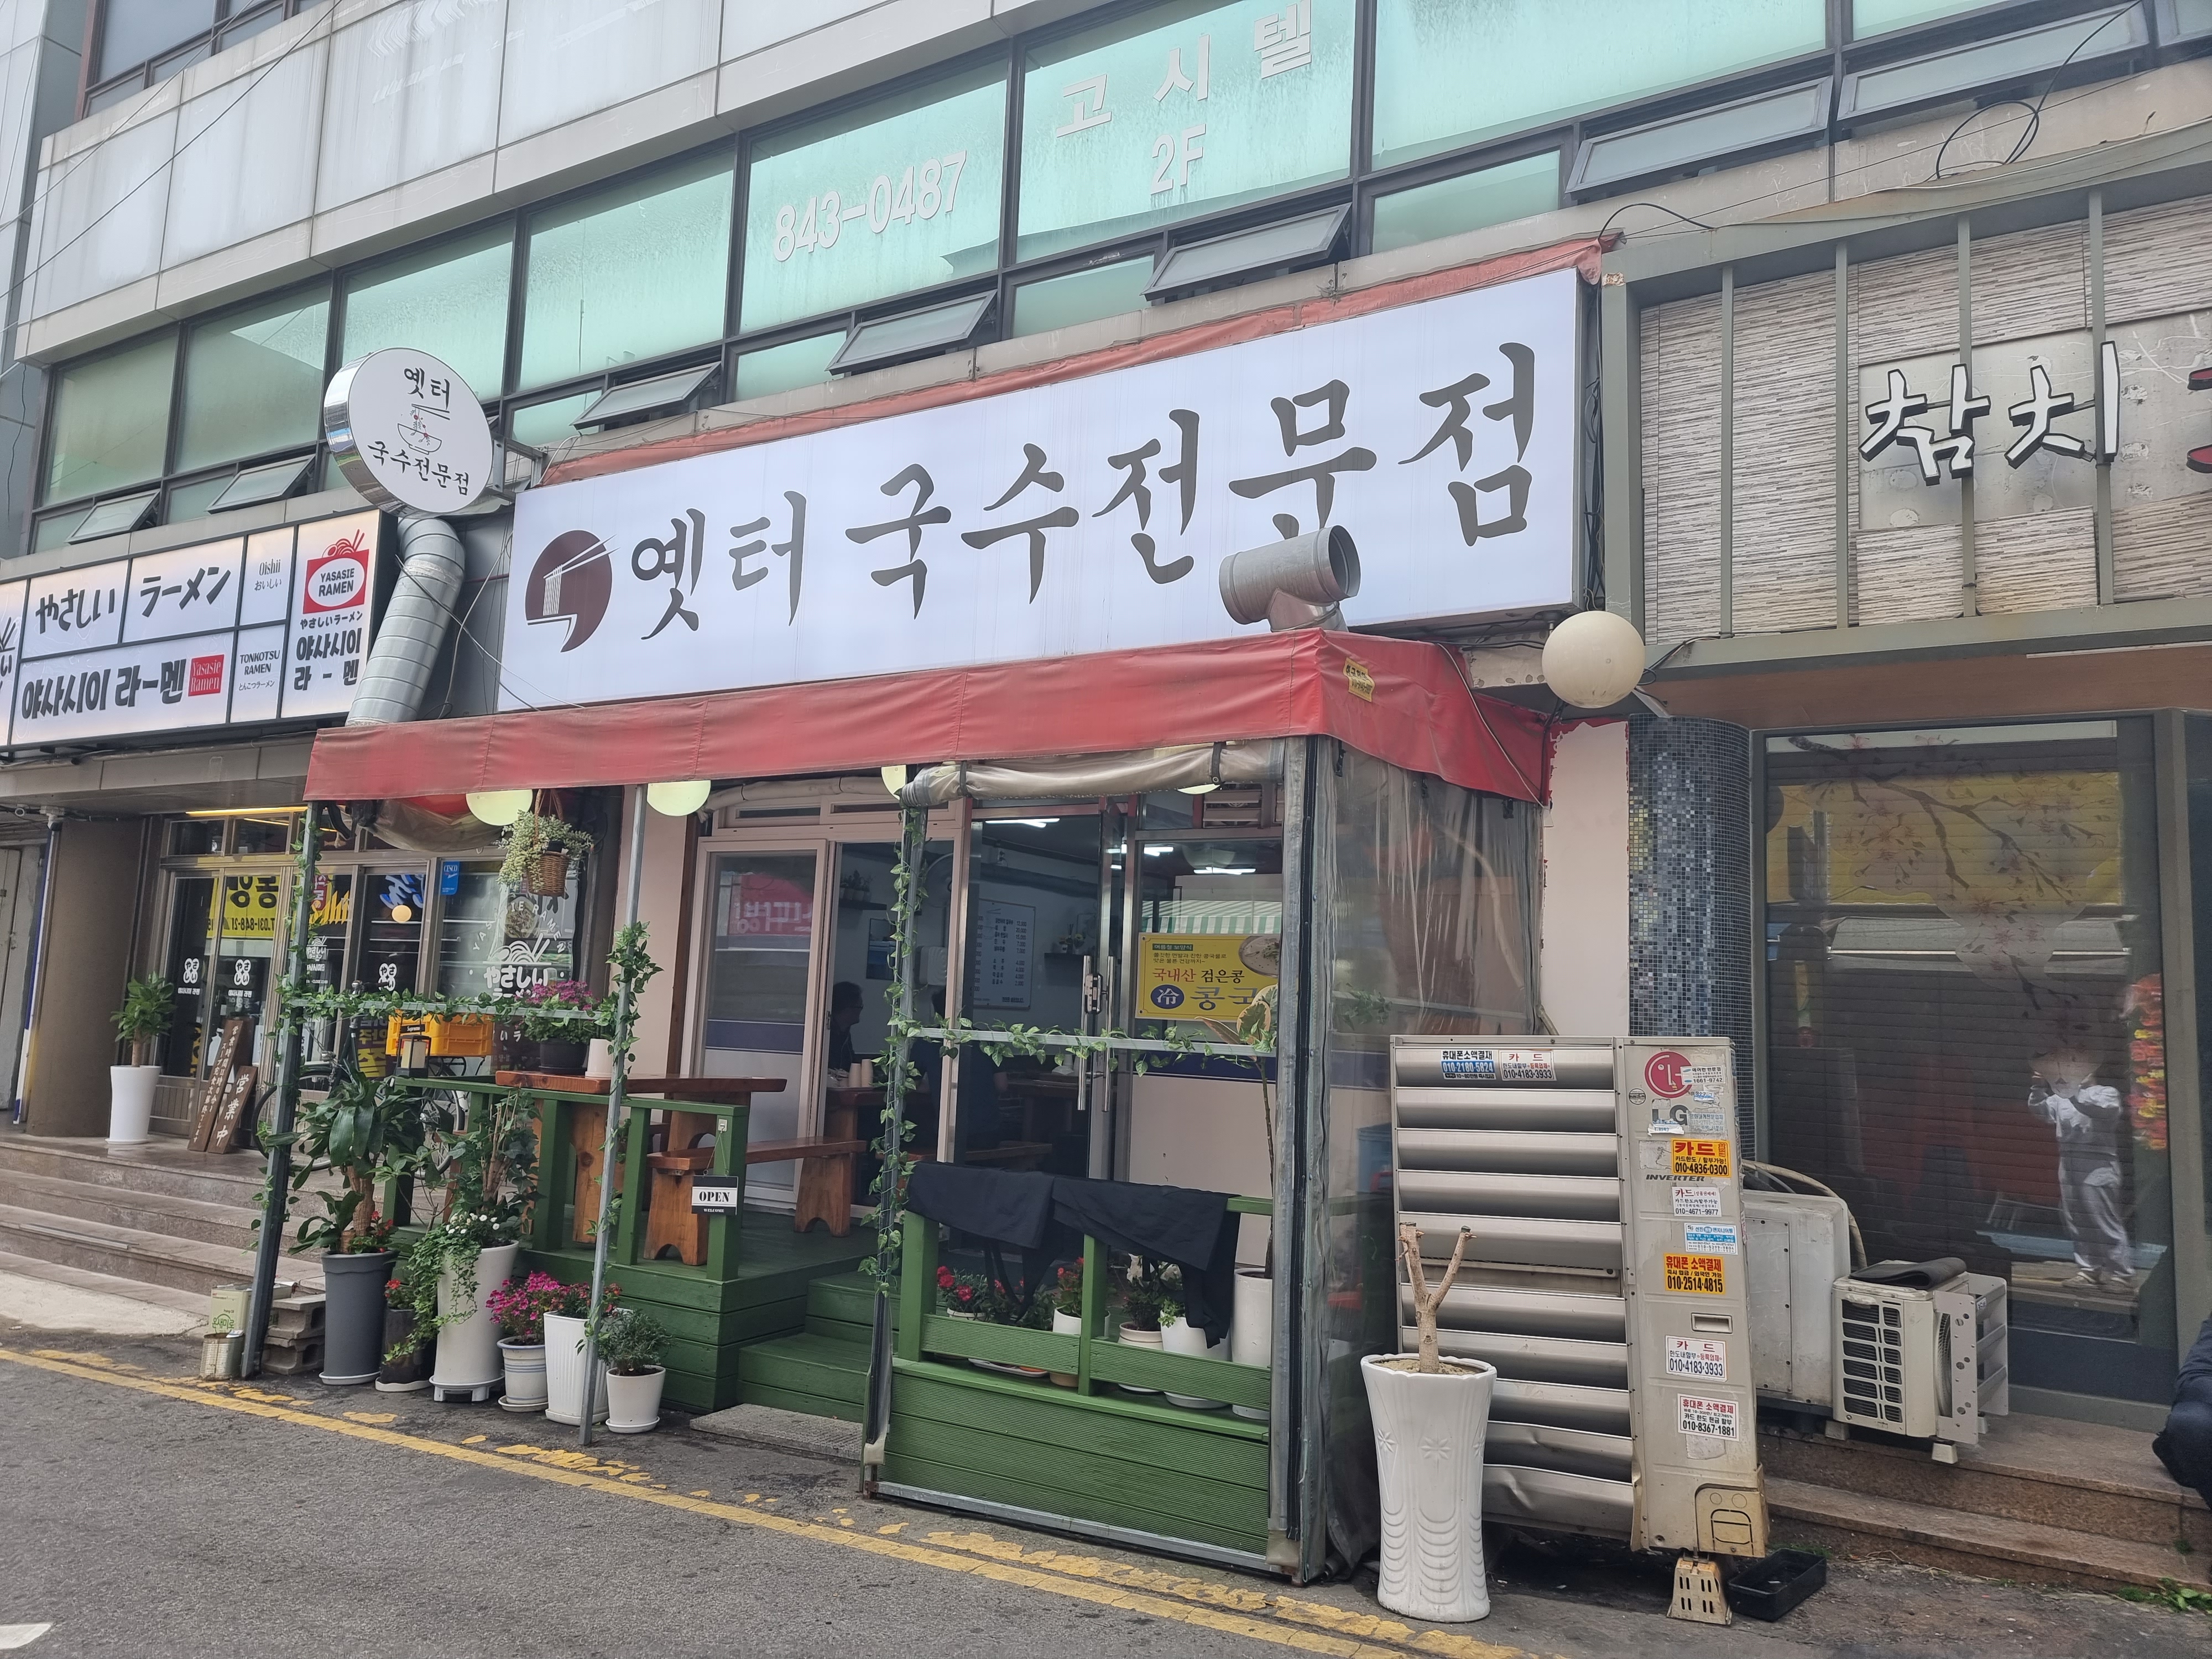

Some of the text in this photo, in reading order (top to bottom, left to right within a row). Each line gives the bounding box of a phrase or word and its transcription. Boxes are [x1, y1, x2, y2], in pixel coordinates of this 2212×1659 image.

[1150, 123, 1206, 196] 2F
[773, 150, 967, 262] 843-0487
[404, 368, 450, 410] 옛터
[367, 441, 468, 495] 국수전문점
[630, 342, 1536, 640] 옛터 국수전문점
[259, 559, 281, 576] Oishii
[321, 568, 354, 582] YASASIE
[140, 567, 231, 618] ラーメン
[254, 578, 281, 591] おいしい
[319, 580, 353, 597] RAMEN
[35, 588, 115, 634] やさしい
[296, 628, 362, 660] 야사시이
[240, 650, 280, 663] TONKOTSU
[192, 660, 221, 675] Yasasie
[244, 663, 271, 675] RAMEN
[191, 677, 220, 692] Ramen
[22, 669, 111, 719] 야사시이
[533, 904, 566, 953] RAMEN
[484, 965, 549, 989] やさしい
[1152, 968, 1245, 984] 국내산 검은콩
[1157, 988, 1180, 1005] 冷
[1652, 1105, 1688, 1126] LG
[1674, 1142, 1715, 1156] 카드
[699, 1191, 730, 1202] OPEN
[1675, 1188, 1694, 1198] 카드
[1666, 1255, 1721, 1272] 휴대폰 소액결제
[1683, 1399, 1733, 1413] 휴대폰 소액결제
[1683, 1420, 1734, 1437] 010-8367-1881
